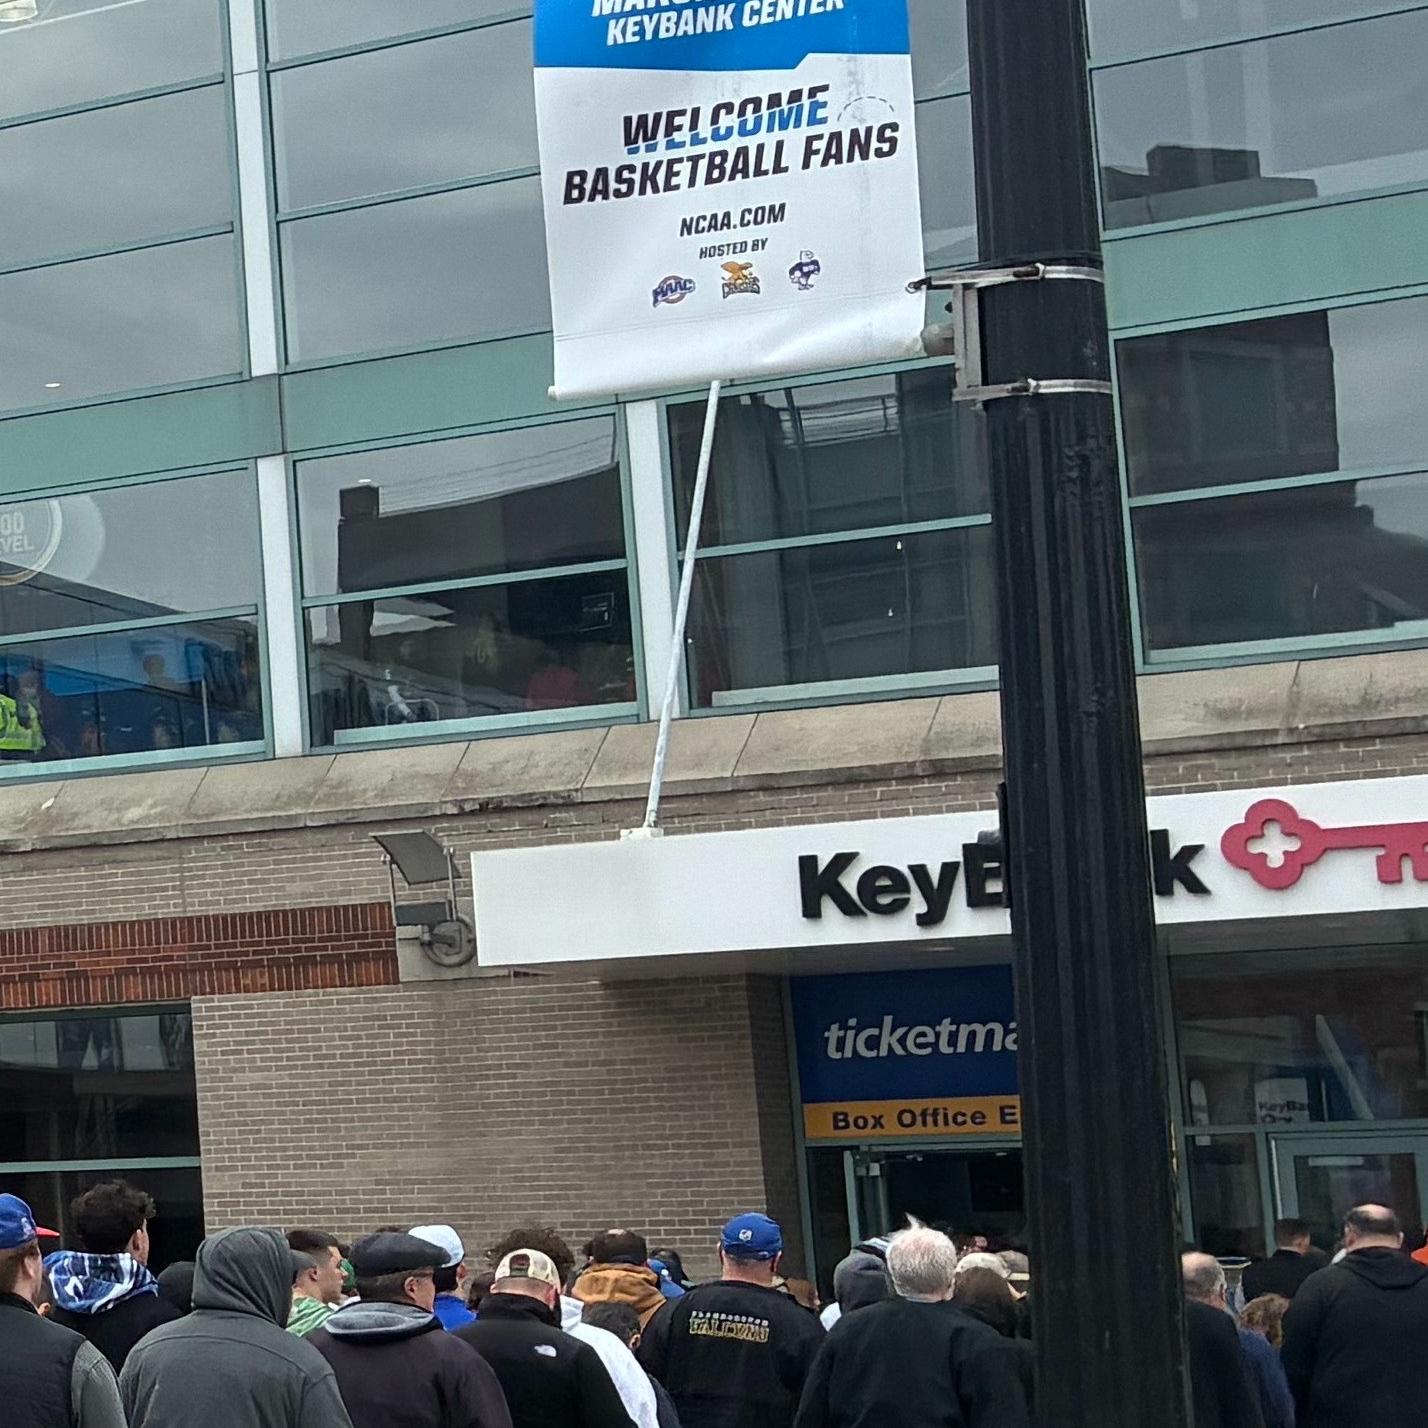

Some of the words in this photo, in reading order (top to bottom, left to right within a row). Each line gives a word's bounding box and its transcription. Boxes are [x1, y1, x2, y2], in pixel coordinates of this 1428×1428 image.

[607, 3, 736, 46] KEYBANK
[623, 84, 830, 155] WELCOME
[563, 139, 789, 205] BASKETBALL
[801, 122, 900, 171] FANS
[680, 202, 787, 237] NCAA.COM
[699, 240, 748, 260] HOSTED
[751, 238, 769, 252] BY
[798, 828, 1212, 926] KeyBk
[832, 1112, 885, 1131] Box
[897, 1107, 987, 1129] Office
